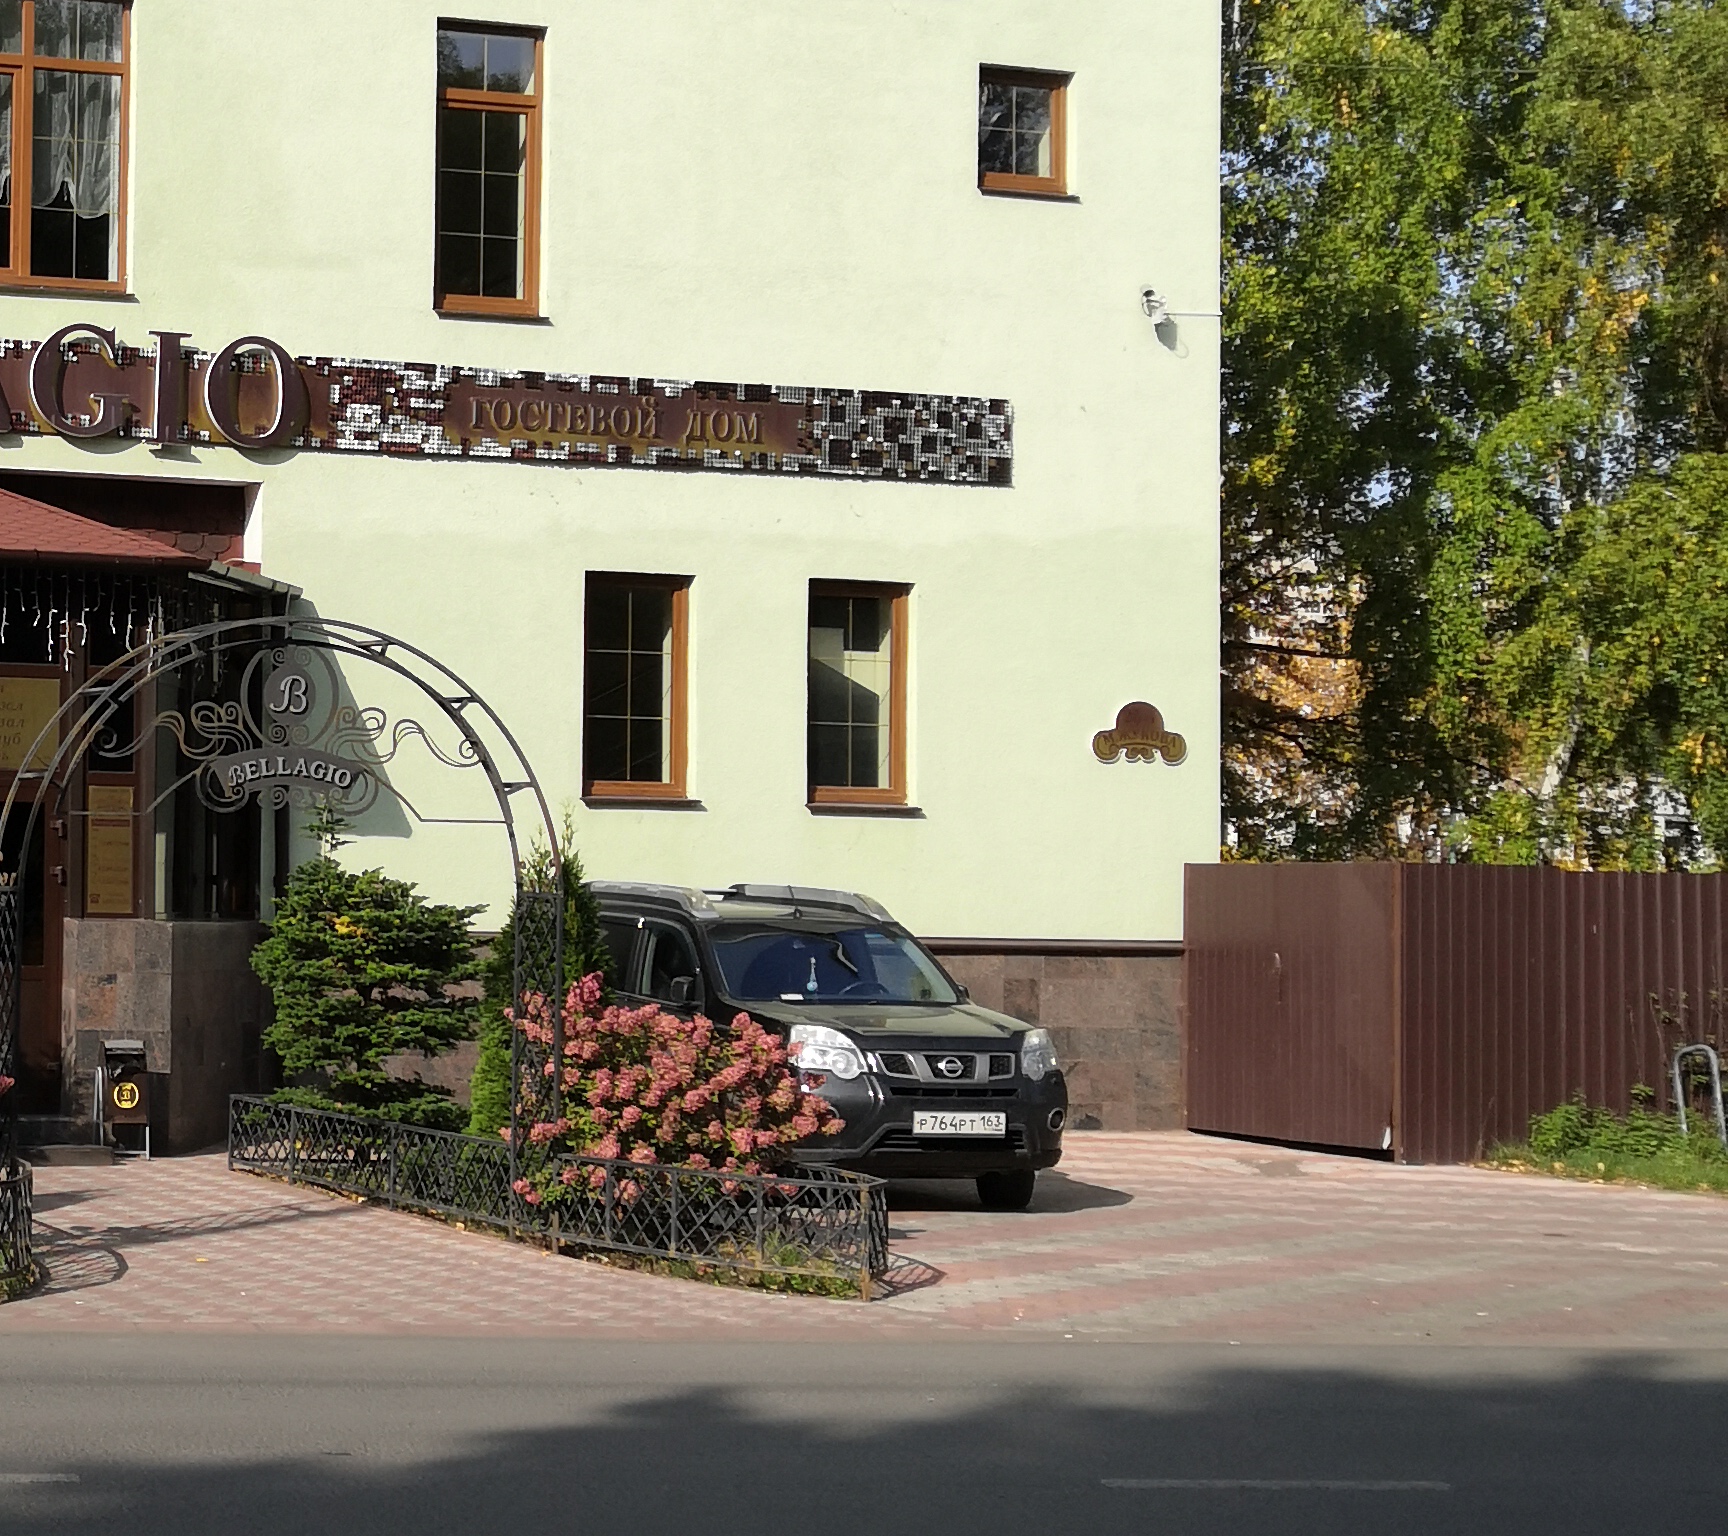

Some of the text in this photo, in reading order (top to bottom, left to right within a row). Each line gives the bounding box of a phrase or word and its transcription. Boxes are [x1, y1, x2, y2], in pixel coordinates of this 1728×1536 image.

[469, 396, 766, 446] ГОСТЕВОЙ ДОМ
[0, 702, 23, 711] зал
[269, 675, 307, 713] B
[228, 756, 352, 787] BELLAGIO
[980, 1115, 1001, 1128] 163
